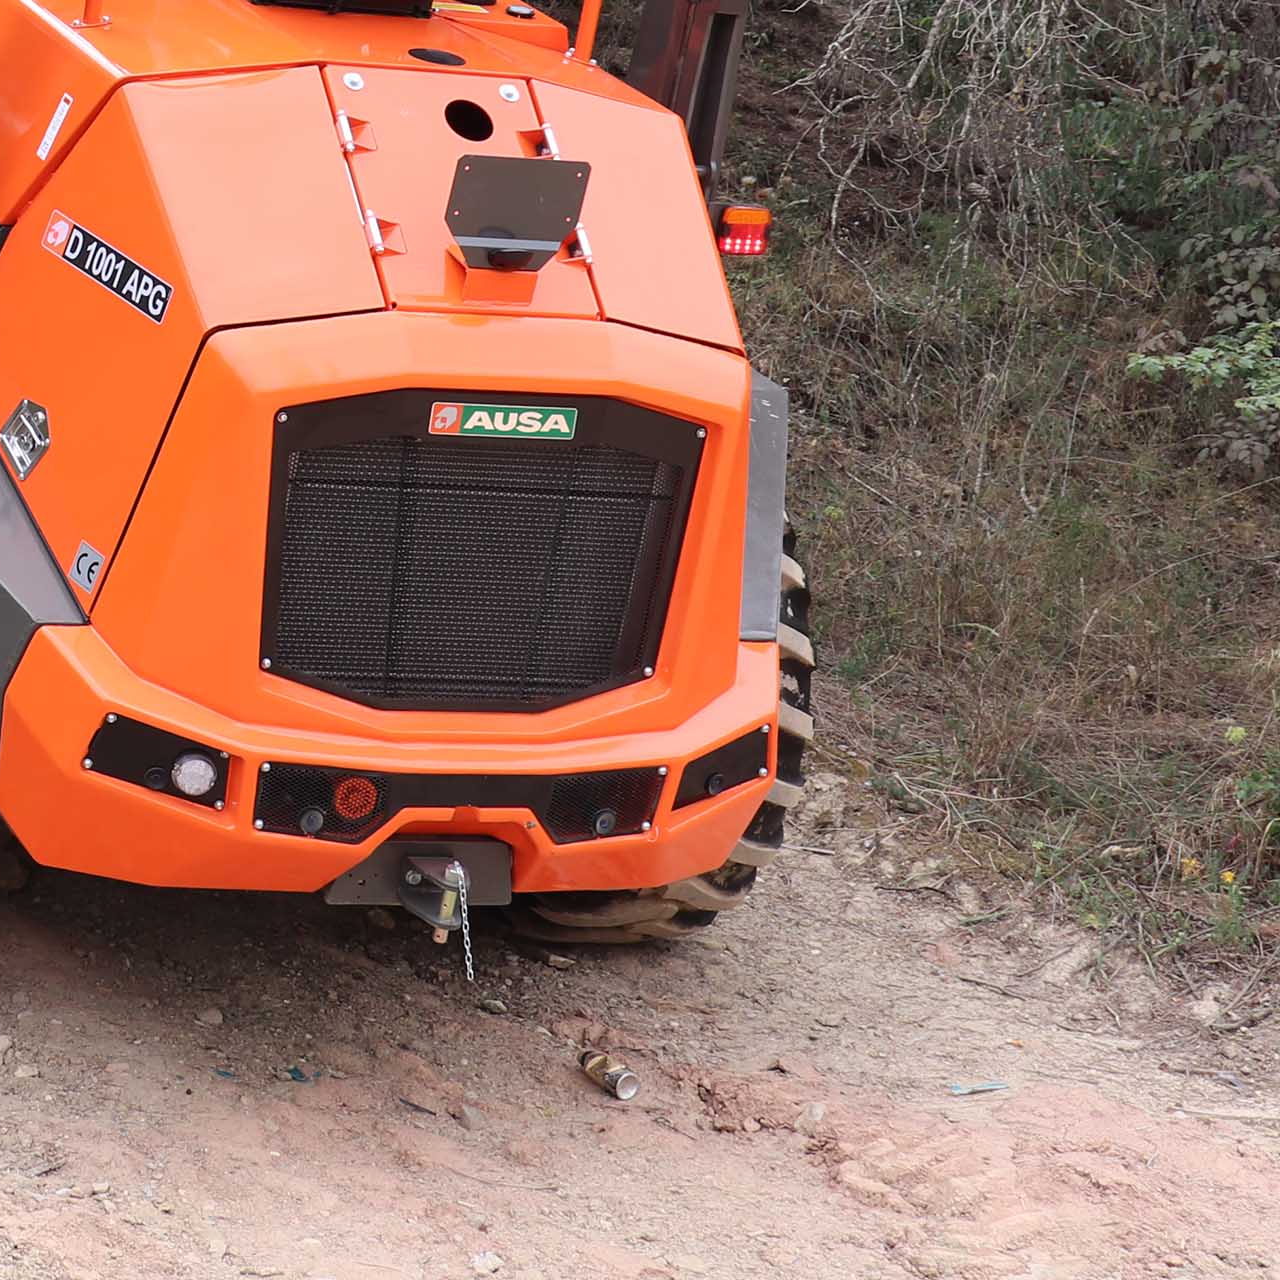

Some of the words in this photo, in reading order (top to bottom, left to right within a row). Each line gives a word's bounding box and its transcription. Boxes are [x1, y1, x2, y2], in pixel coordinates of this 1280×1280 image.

[64, 228, 84, 259] D
[85, 241, 125, 288] 1001
[122, 269, 166, 316] APG
[463, 411, 570, 433] AUSA
[77, 553, 99, 584] CE
